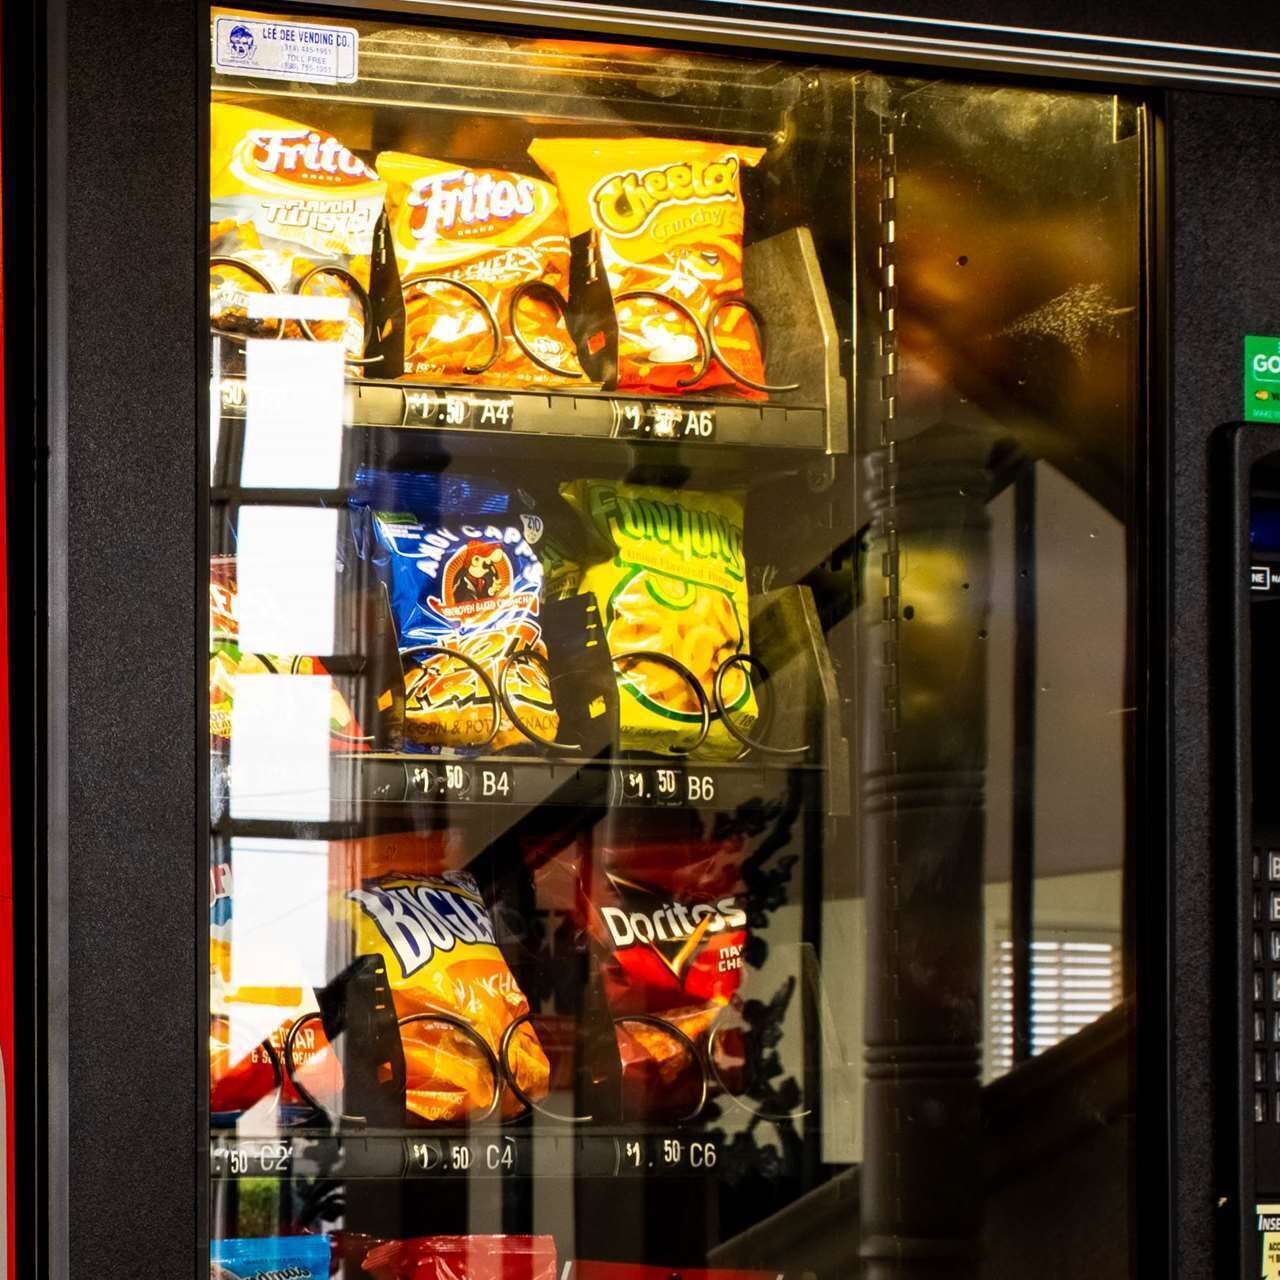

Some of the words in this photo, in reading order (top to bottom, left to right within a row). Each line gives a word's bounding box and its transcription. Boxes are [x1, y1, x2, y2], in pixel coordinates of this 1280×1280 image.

[263, 28, 277, 40] LEE
[280, 29, 295, 41] DEE
[299, 31, 333, 46] VENDING
[336, 34, 350, 48] CO.
[407, 169, 536, 240] Fritos
[481, 401, 509, 425] A4
[685, 410, 713, 436] A6
[483, 770, 510, 796] B4
[688, 775, 715, 801] B6
[601, 898, 747, 948] Doritos
[486, 1144, 513, 1170] C4
[690, 1143, 717, 1169] C6
